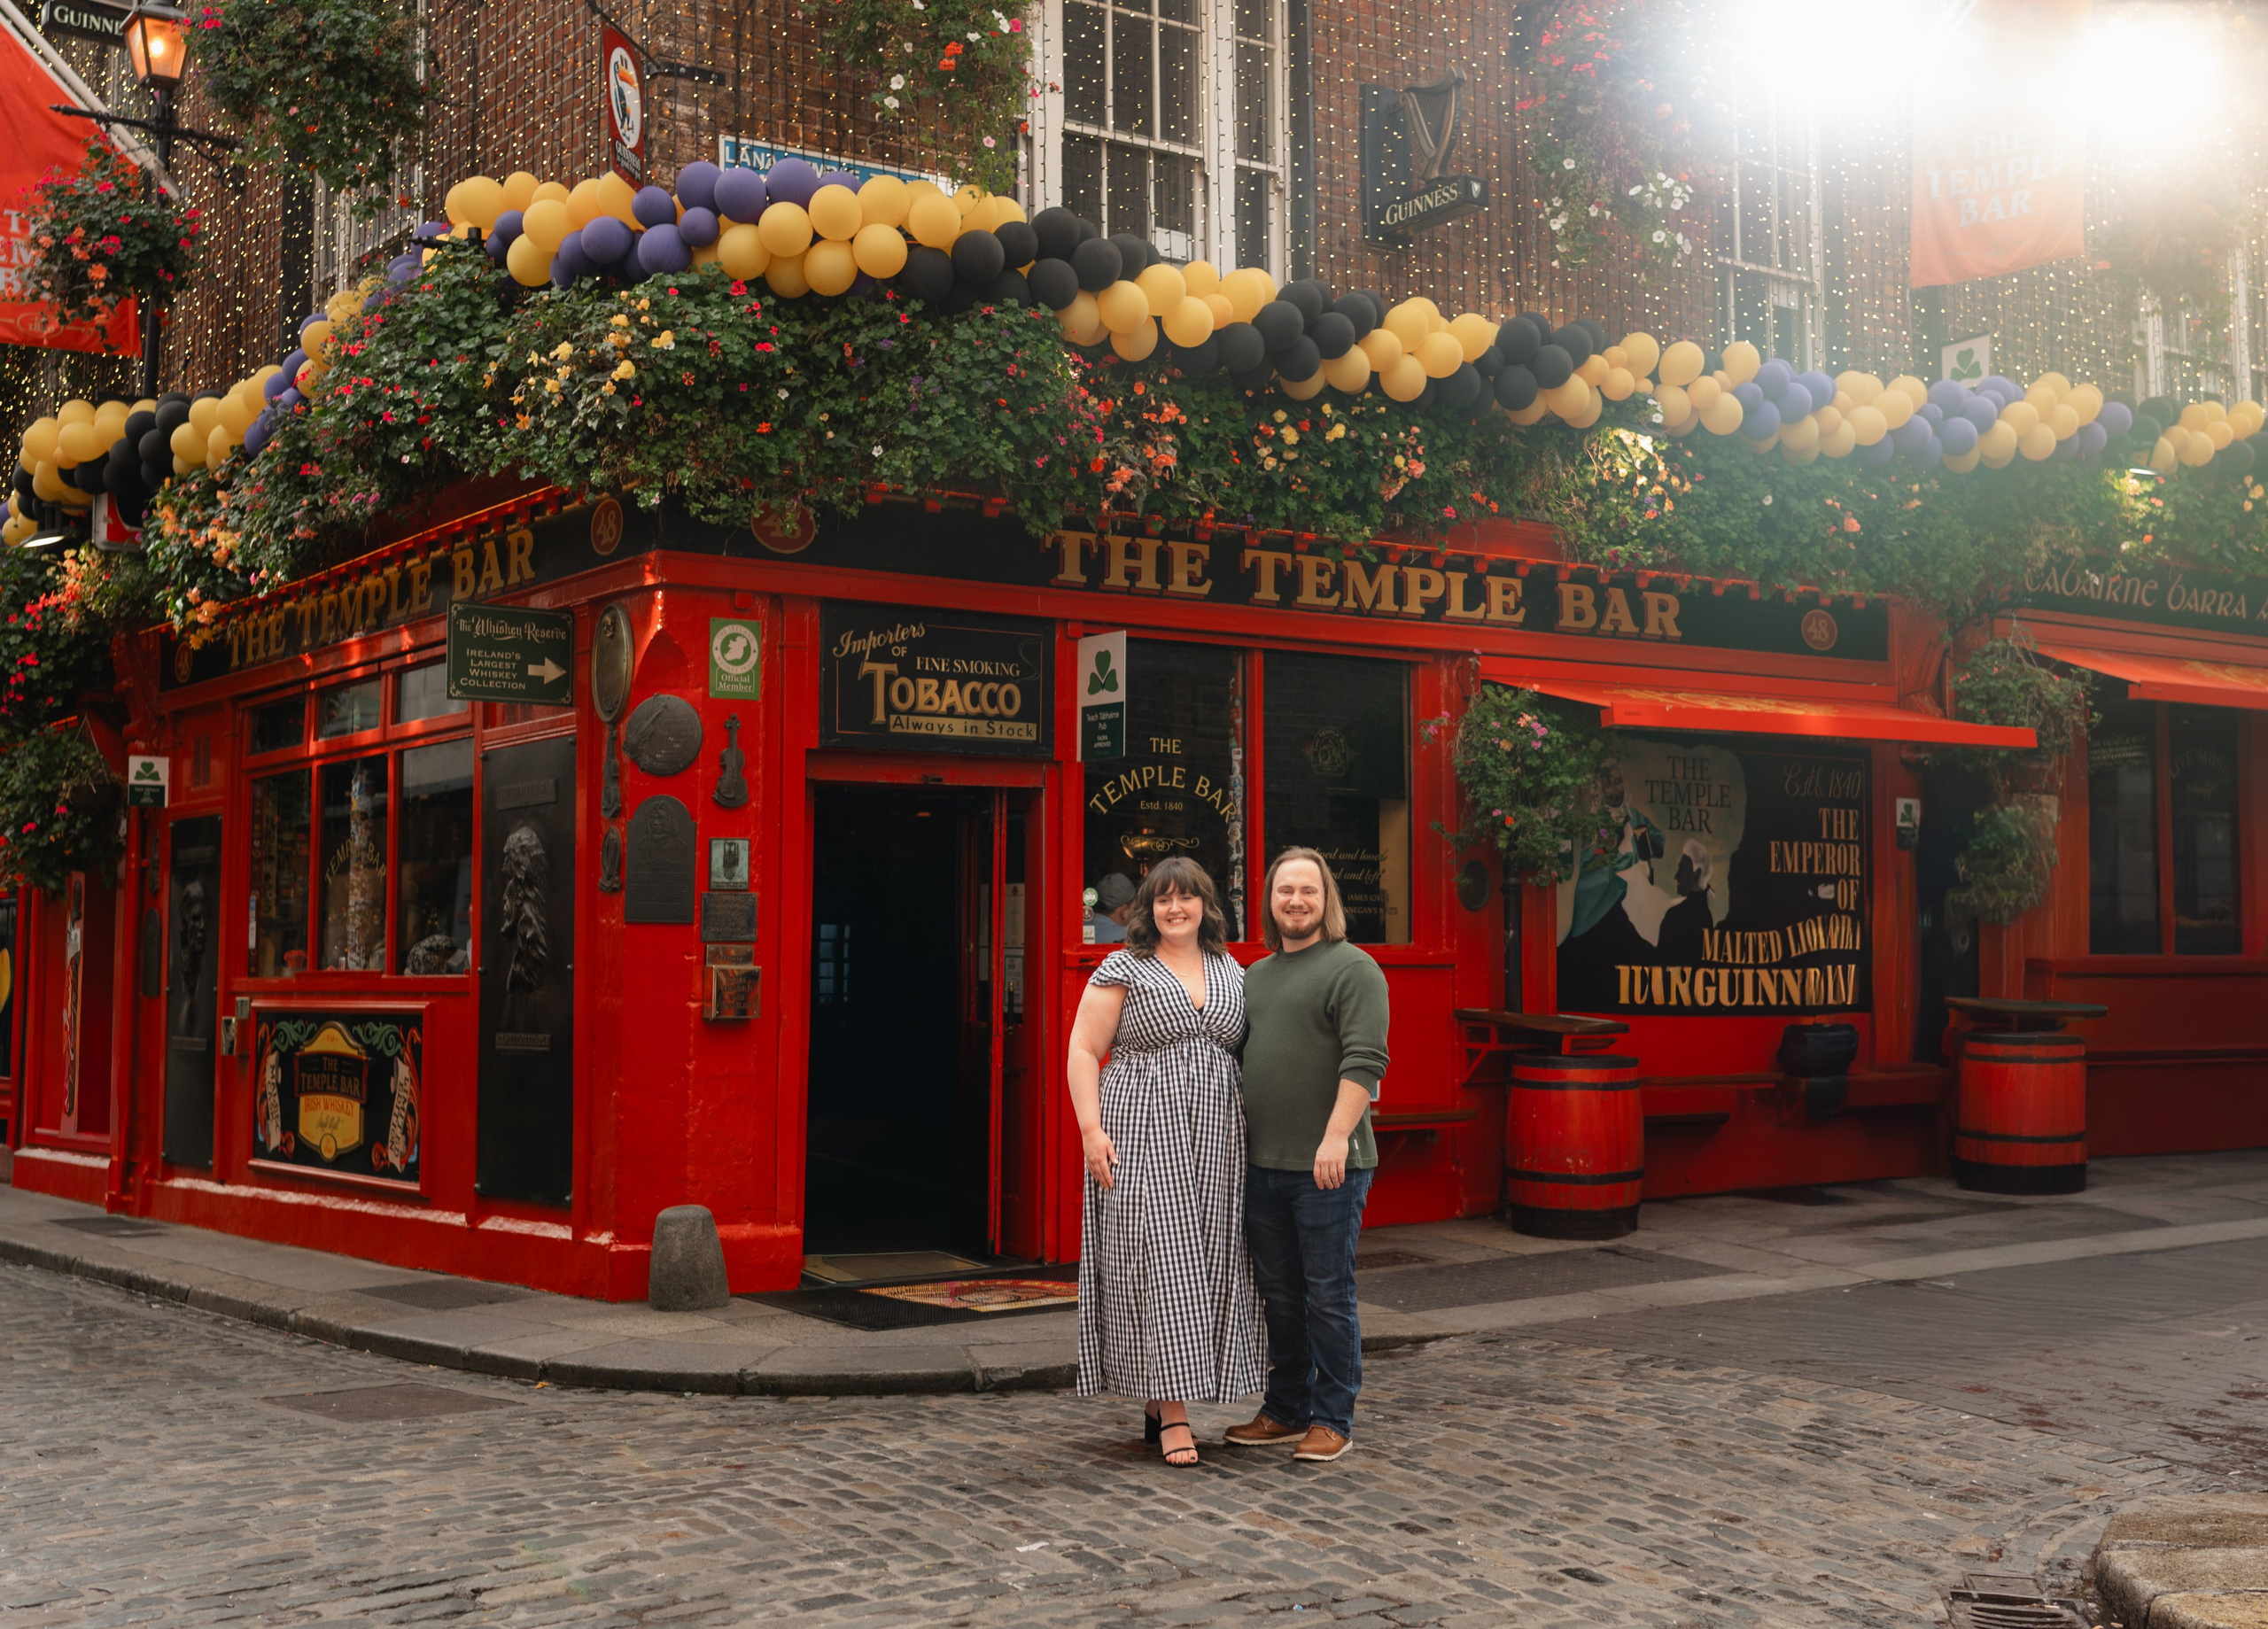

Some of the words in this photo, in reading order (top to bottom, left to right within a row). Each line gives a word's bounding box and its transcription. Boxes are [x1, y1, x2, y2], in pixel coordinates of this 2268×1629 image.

[53, 4, 124, 36] GUINNE
[615, 140, 641, 172] GUINNESS
[1969, 130, 2029, 160] THE
[1925, 141, 2068, 199] TEMPLE
[1385, 182, 1459, 225] GUINNESS
[1958, 188, 2034, 228] BAR
[594, 509, 617, 547] 48
[227, 609, 287, 668] THE
[298, 562, 434, 647] TEMPLE
[450, 528, 536, 601] BAR
[1040, 529, 1213, 600] THE
[1240, 547, 1527, 624] TEMPLE
[1557, 582, 1682, 640] BAR
[456, 618, 472, 632] The
[471, 615, 523, 640] Whiskey
[524, 622, 566, 644] Reserve
[728, 625, 756, 644] IRELAND
[832, 622, 927, 661] Importers
[1806, 617, 1829, 641] 48
[891, 646, 907, 657] OF
[916, 656, 950, 672] FINE
[952, 660, 1021, 677] SMOKING
[718, 681, 752, 691] Member
[721, 673, 750, 683] Official
[858, 662, 1021, 725] TOBACCO
[892, 716, 954, 734] Always
[964, 720, 978, 734] in
[986, 721, 1035, 738] Stock
[1150, 737, 1182, 755] THE
[1666, 755, 1712, 781] THE
[1089, 765, 1186, 815] TEMPLE
[1194, 775, 1238, 824] BAR
[1644, 779, 1732, 809] TEMPLE
[1828, 769, 1861, 799] 1840
[1140, 800, 1161, 811] Estd.
[1164, 802, 1183, 811] 1840
[1667, 805, 1713, 834] BAR
[1818, 807, 1859, 841] THE
[367, 841, 387, 884] BAR
[1339, 848, 1359, 861] and
[1769, 840, 1861, 877] EMPEROR
[1343, 867, 1363, 880] and
[1347, 894, 1369, 903] JAMES
[1837, 878, 1860, 911] OF
[1701, 927, 1783, 965] MALTED
[322, 1056, 338, 1073] THE
[300, 1072, 338, 1092] TEMPLE
[340, 1074, 361, 1098] BAR
[304, 1097, 321, 1113] IRISH
[322, 1097, 354, 1118] WHISKEY
[389, 1081, 404, 1152] EDITION
[393, 1075, 410, 1158] LIMITED
